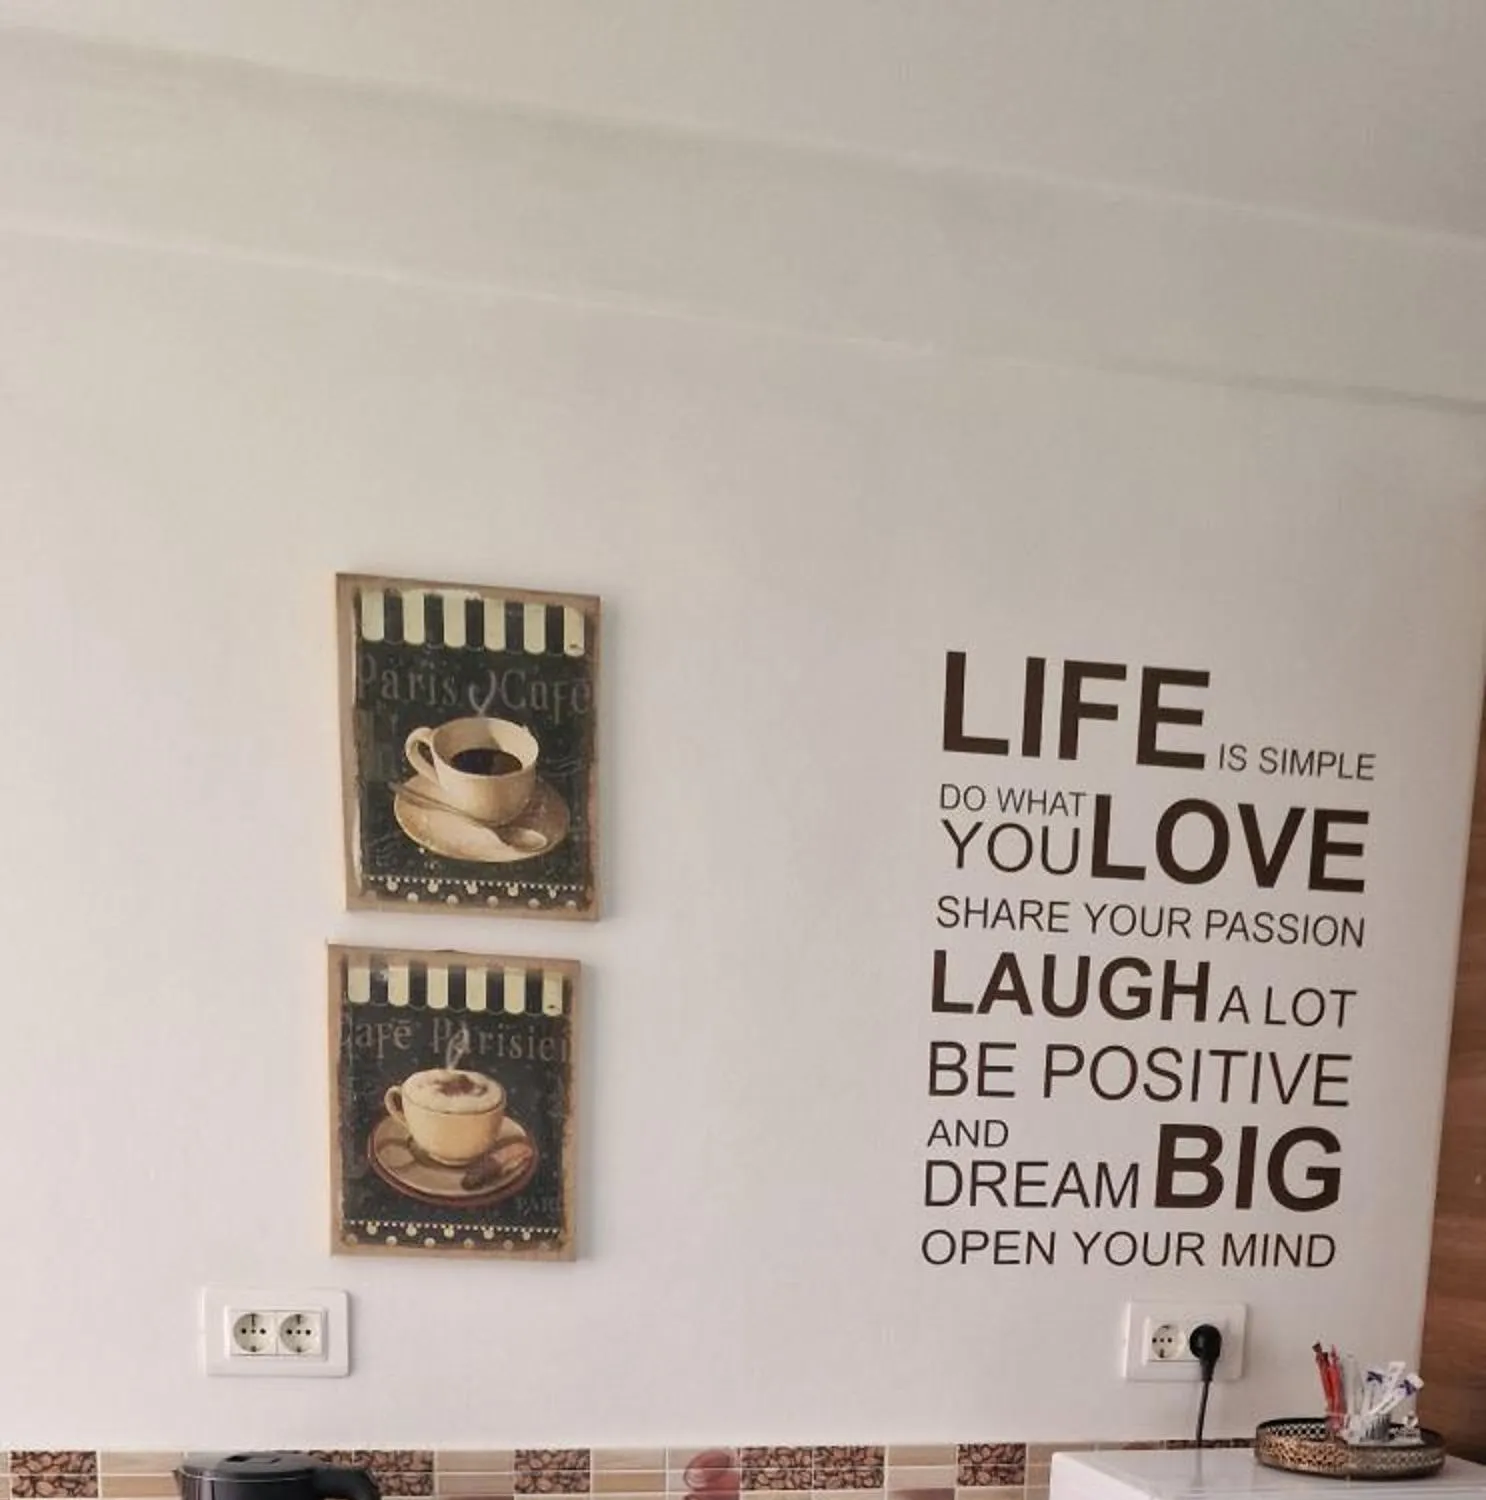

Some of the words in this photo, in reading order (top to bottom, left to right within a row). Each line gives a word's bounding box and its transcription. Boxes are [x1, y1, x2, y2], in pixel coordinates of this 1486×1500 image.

[356, 652, 457, 706] Paris
[942, 650, 1211, 770] LIFE
[1219, 743, 1247, 772] IS
[1259, 746, 1376, 781] SIMPLE
[940, 783, 986, 812] DO
[997, 788, 1086, 817] WHAT
[941, 819, 1080, 876] YOU
[1091, 793, 1370, 894] LOVE
[937, 895, 1070, 933] SHARE
[1084, 903, 1192, 939] YOUR
[1205, 909, 1365, 948] PASSION
[931, 949, 1211, 1023] LAUGH
[1218, 985, 1250, 1025] A
[1264, 986, 1358, 1029] LOT
[928, 1041, 1017, 1098] BE
[1043, 1043, 1353, 1108] POSITIVE
[927, 1119, 1009, 1148] AND
[924, 1159, 1140, 1209] DREAM
[1154, 1123, 1342, 1213] BIG
[921, 1229, 1056, 1265] OPEN
[1073, 1231, 1205, 1267] YOUR
[1221, 1232, 1336, 1268] MIND
